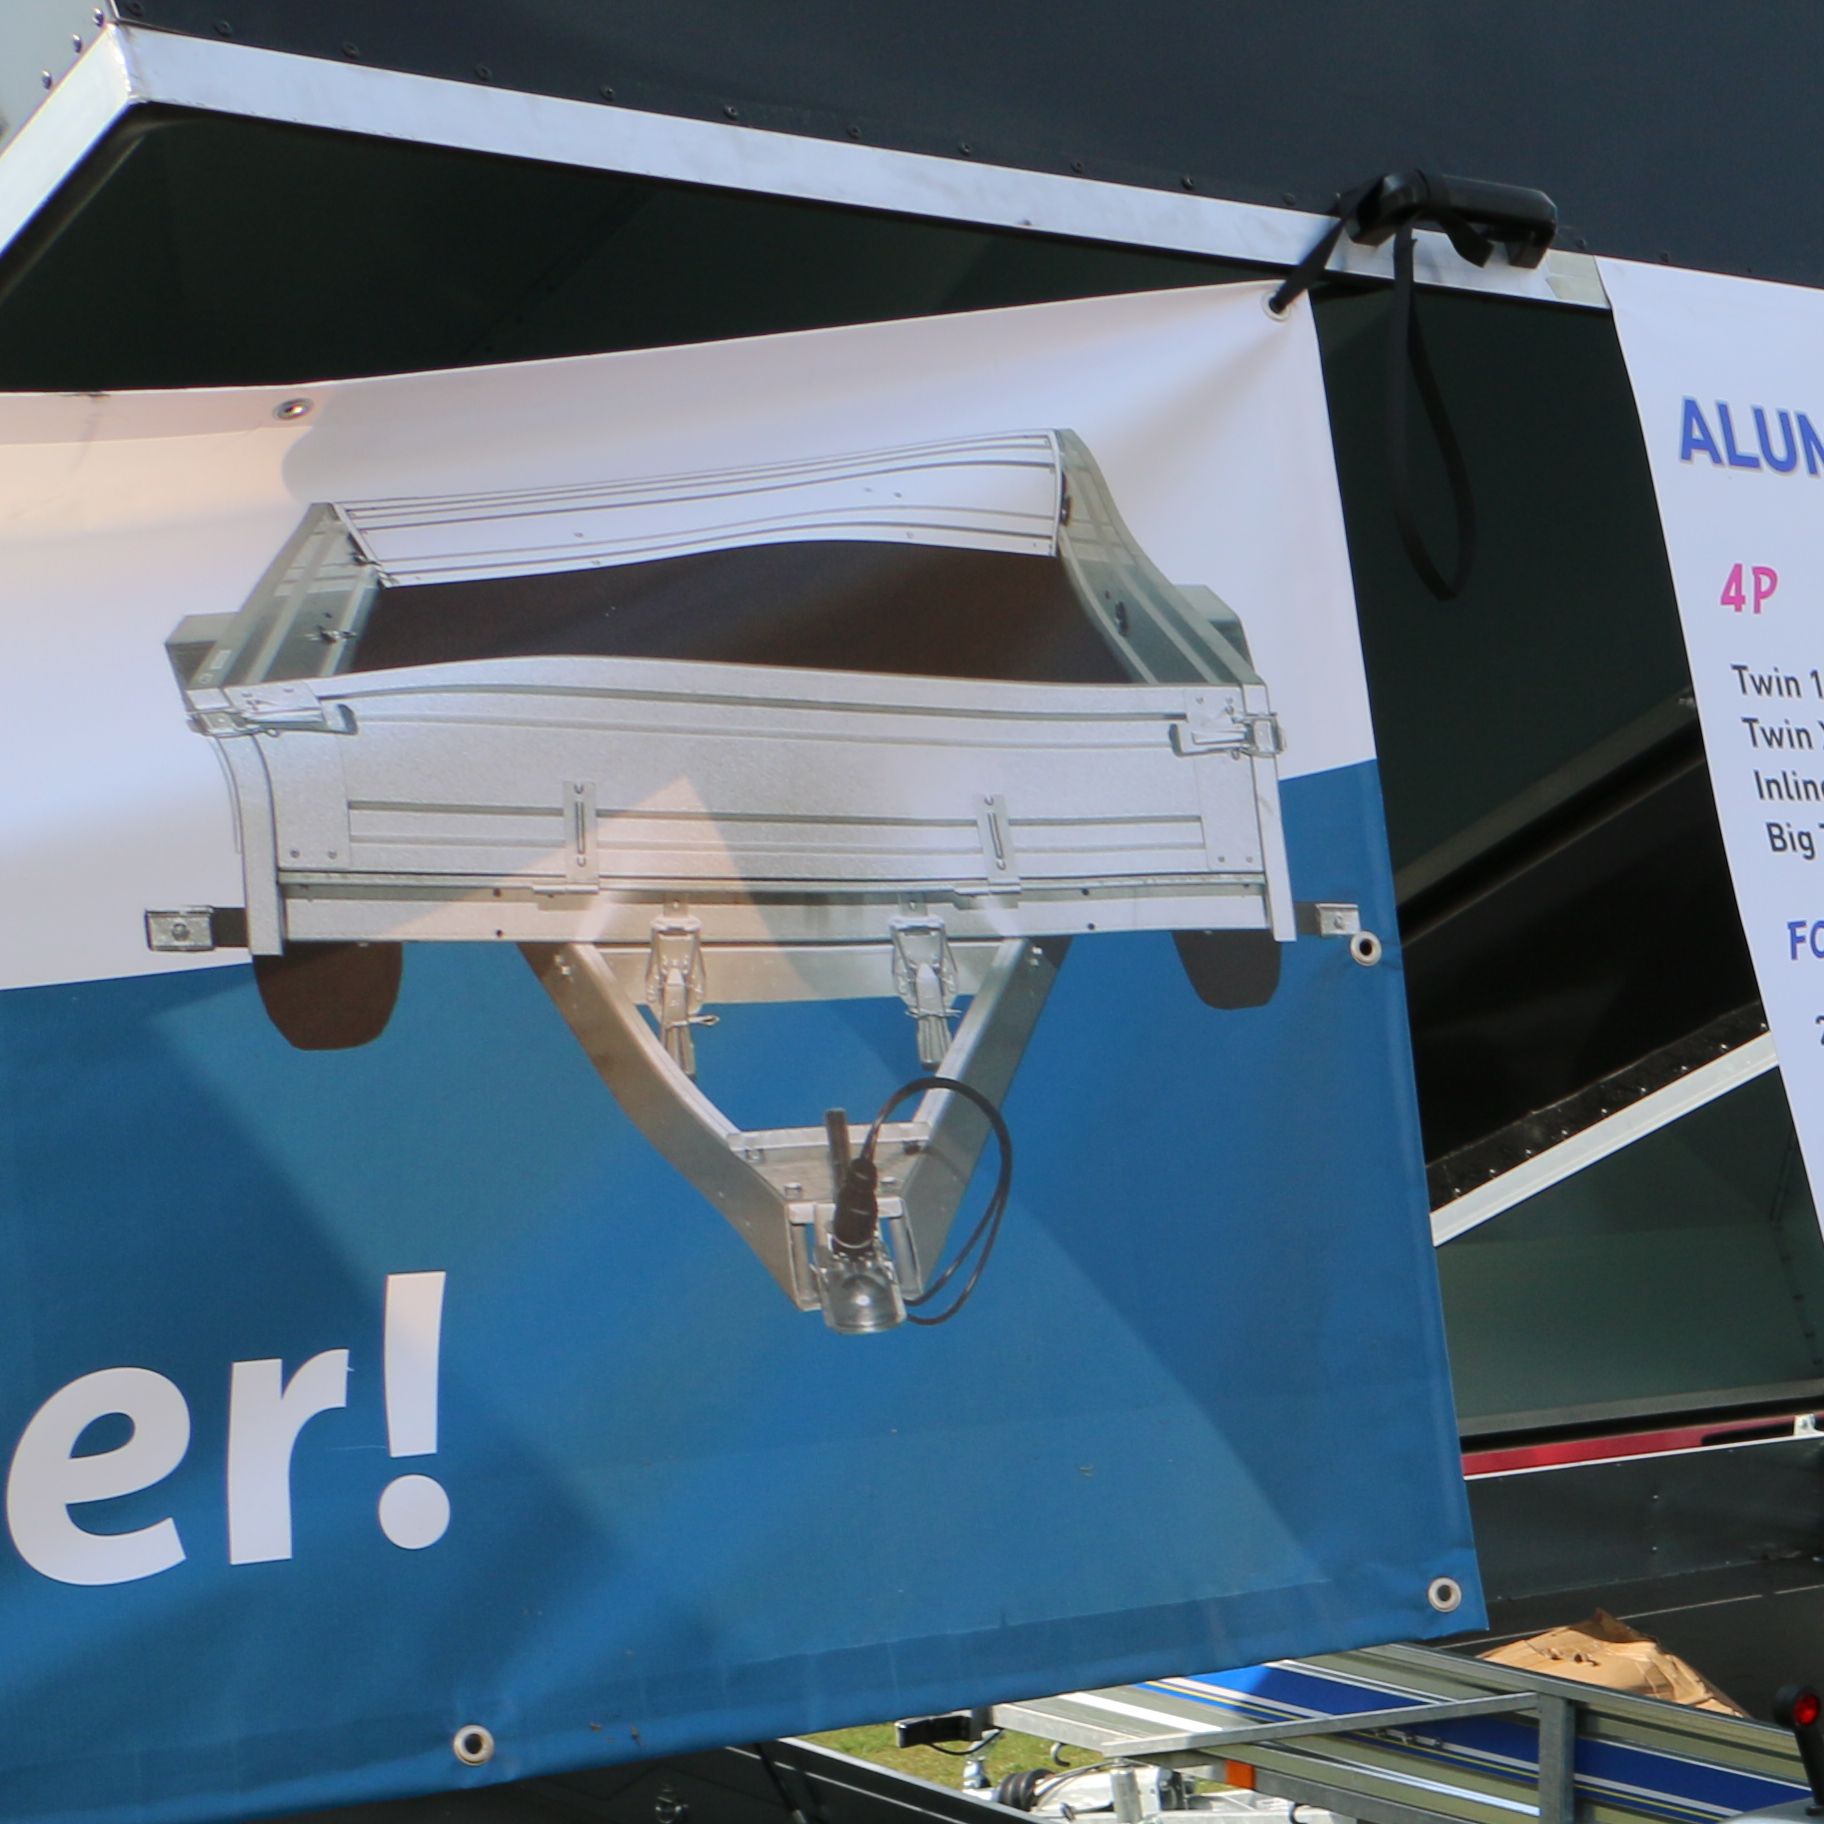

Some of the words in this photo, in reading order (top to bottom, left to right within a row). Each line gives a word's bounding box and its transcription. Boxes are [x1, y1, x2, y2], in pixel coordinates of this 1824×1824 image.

[1720, 562, 1779, 614] 4P
[1731, 663, 1802, 699] Twin
[1742, 717, 1815, 752] Twin
[1765, 821, 1816, 862] Big
[6, 1271, 450, 1586] er!
